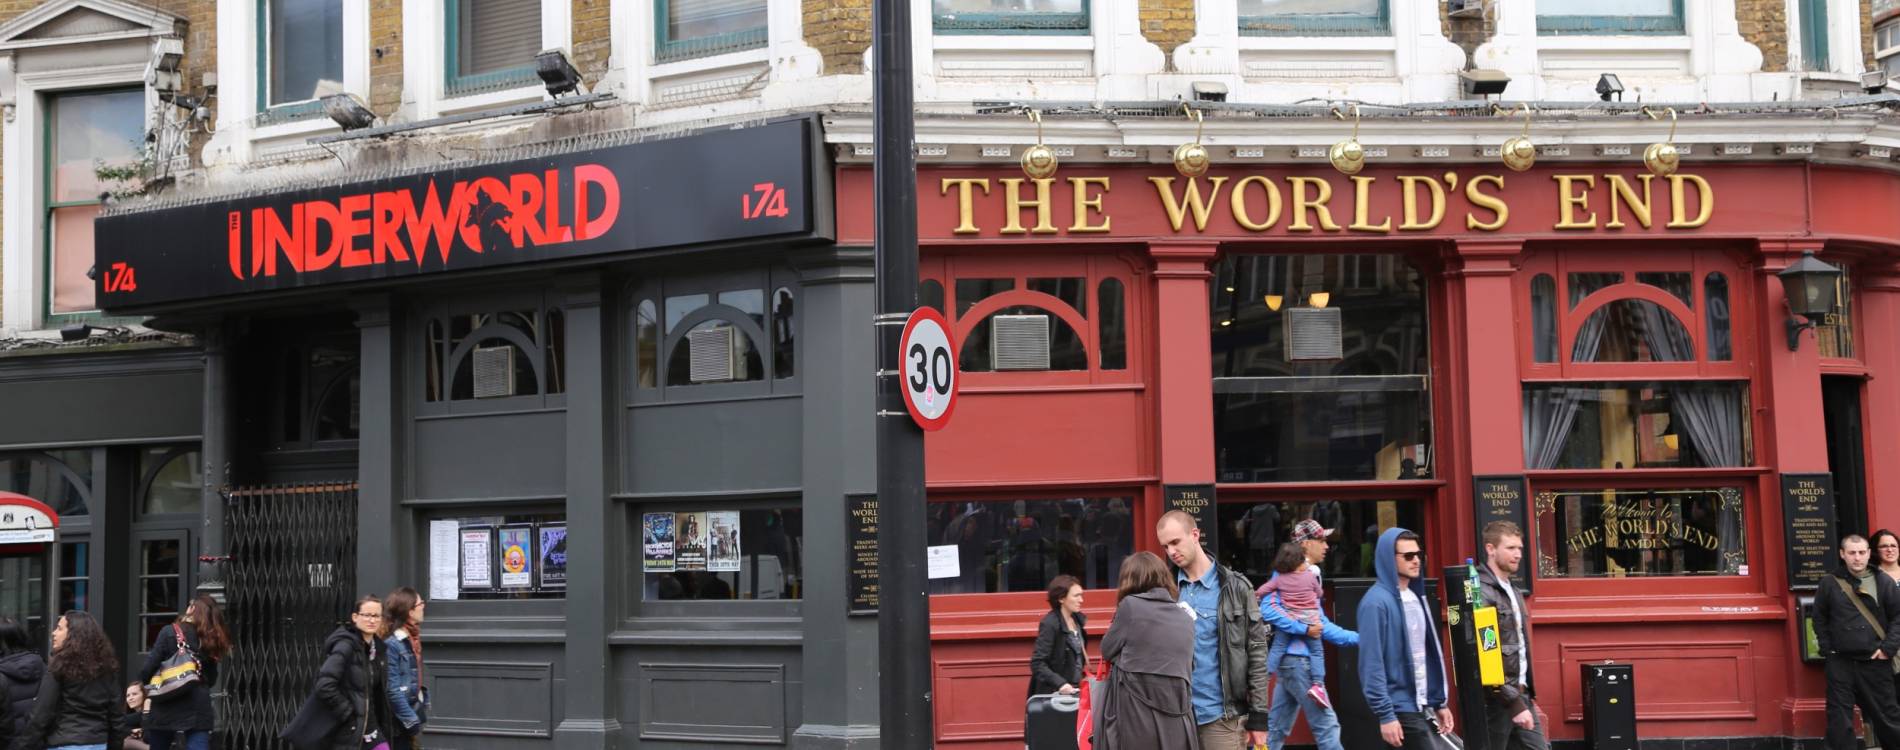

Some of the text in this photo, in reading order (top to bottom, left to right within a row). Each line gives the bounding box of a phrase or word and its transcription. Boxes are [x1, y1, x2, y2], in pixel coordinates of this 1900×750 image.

[742, 182, 789, 219] 174
[940, 171, 1715, 235] THE WORLD'S END
[228, 163, 621, 281] UNDERWORLD
[103, 261, 137, 293] 174
[909, 342, 951, 396] 30
[1490, 484, 1509, 492] THE
[1798, 480, 1816, 488] THE
[1181, 491, 1200, 499] THE
[1481, 490, 1519, 499] WORLD'S
[1788, 487, 1826, 496] WORLD'S
[1171, 497, 1209, 507] WORLD'S
[1491, 499, 1511, 507] END
[1799, 495, 1818, 503] END
[852, 509, 878, 517] WORL
[1565, 518, 1719, 553] THE WORLD'S END
